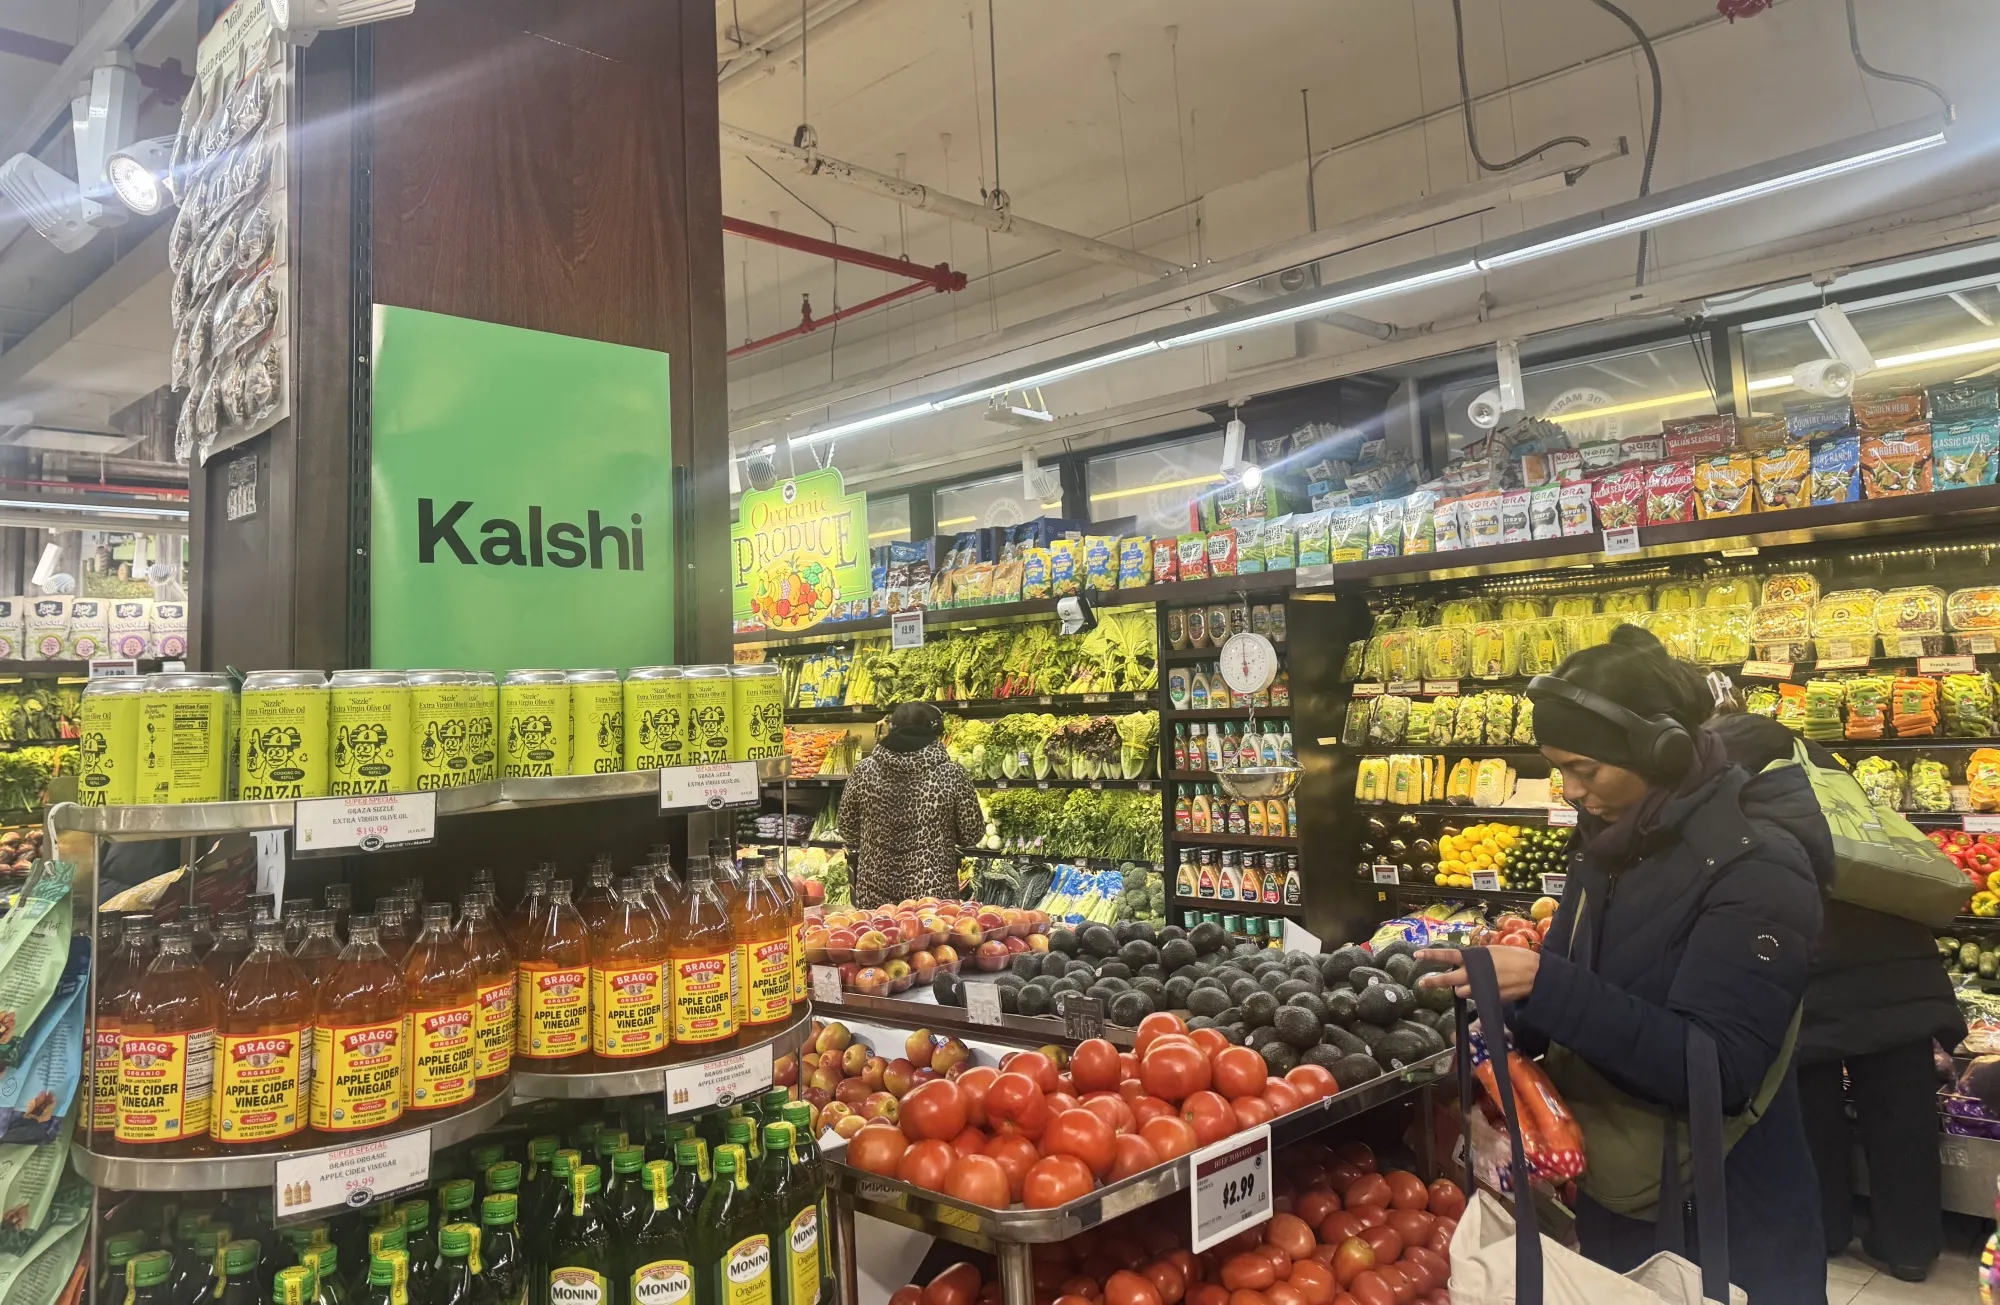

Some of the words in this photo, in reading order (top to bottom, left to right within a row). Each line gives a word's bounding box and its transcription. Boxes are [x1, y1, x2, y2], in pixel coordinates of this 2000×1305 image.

[1932, 438, 1961, 449] CLASSIC
[1962, 433, 1990, 445] CAESAR
[751, 492, 830, 529] Organic
[417, 497, 644, 571] Kalshi
[733, 510, 858, 587] PRODUCE
[102, 711, 112, 719] Oil
[258, 707, 278, 716] Virgin
[296, 706, 306, 714] Oil
[346, 705, 366, 714] Virgin
[637, 753, 682, 770] GRAZA
[504, 763, 552, 777] GRAZA
[243, 785, 302, 800] GRAZA
[331, 780, 390, 796] GRAZA
[704, 788, 728, 796] $19.99
[368, 796, 398, 804] SPECIAL
[347, 807, 371, 815] GRAZA
[356, 825, 389, 836] $19.99
[761, 943, 789, 956] BRAGG
[685, 961, 721, 972] BRAGG
[544, 973, 581, 985] BRAGG
[616, 973, 653, 985] BRAGG
[752, 977, 777, 989] APPLE
[547, 996, 577, 1004] ORGANIC
[677, 997, 703, 1006] APPLE
[705, 992, 729, 1005] CIDER
[534, 1010, 563, 1020] APPLE
[563, 1006, 587, 1018] CIDER
[608, 1009, 635, 1019] APPLE
[637, 1004, 661, 1017] CIDER
[685, 1003, 722, 1015] VINEGAR
[430, 1012, 469, 1027] BRAGG
[542, 1017, 580, 1029] VINEGAR
[616, 1016, 654, 1029] VINEGAR
[188, 1030, 212, 1040] Nutrition
[349, 1030, 393, 1045] BRAGG
[434, 1037, 466, 1047] ORGANIC
[125, 1042, 168, 1053] BRAGG
[238, 1040, 286, 1054] BRAGG
[353, 1056, 389, 1066] ORGANIC
[417, 1053, 450, 1066] APPLE
[453, 1047, 474, 1062] CIDER
[241, 1067, 280, 1076] ORGANIC
[428, 1060, 468, 1076] VINEGAR
[336, 1074, 371, 1086] APPLE
[373, 1066, 399, 1082] CIDER
[697, 1079, 715, 1088] APPLE
[715, 1075, 731, 1083] CIDER
[118, 1085, 140, 1096] APPLE
[142, 1083, 178, 1096] CIDER
[225, 1085, 259, 1096] APPLE
[262, 1079, 295, 1094] CIDER
[347, 1080, 392, 1096] VINEGAR
[716, 1083, 737, 1094] $9.99
[122, 1096, 165, 1108] VINEGAR
[235, 1093, 284, 1107] VINEGAR
[238, 1122, 279, 1131] UNPASTEURIZED
[328, 1149, 354, 1160] SUPER
[356, 1142, 387, 1154] SPECIAL
[1214, 1157, 1229, 1169] BEEF
[1229, 1147, 1252, 1163] TOMATO
[329, 1160, 355, 1170] BRAGG
[357, 1152, 387, 1164] ORGANIC
[320, 1173, 344, 1182] APPLE
[344, 1167, 366, 1177] CIDER
[367, 1159, 397, 1172] VINEGAR
[345, 1176, 375, 1191] $9.99
[1222, 1173, 1255, 1210] $2.99
[1258, 1192, 1266, 1202] LB
[730, 1252, 768, 1276] MONINI
[552, 1287, 598, 1300] MONINI
[638, 1280, 687, 1297] MONINI
[735, 1280, 767, 1298] Originale
